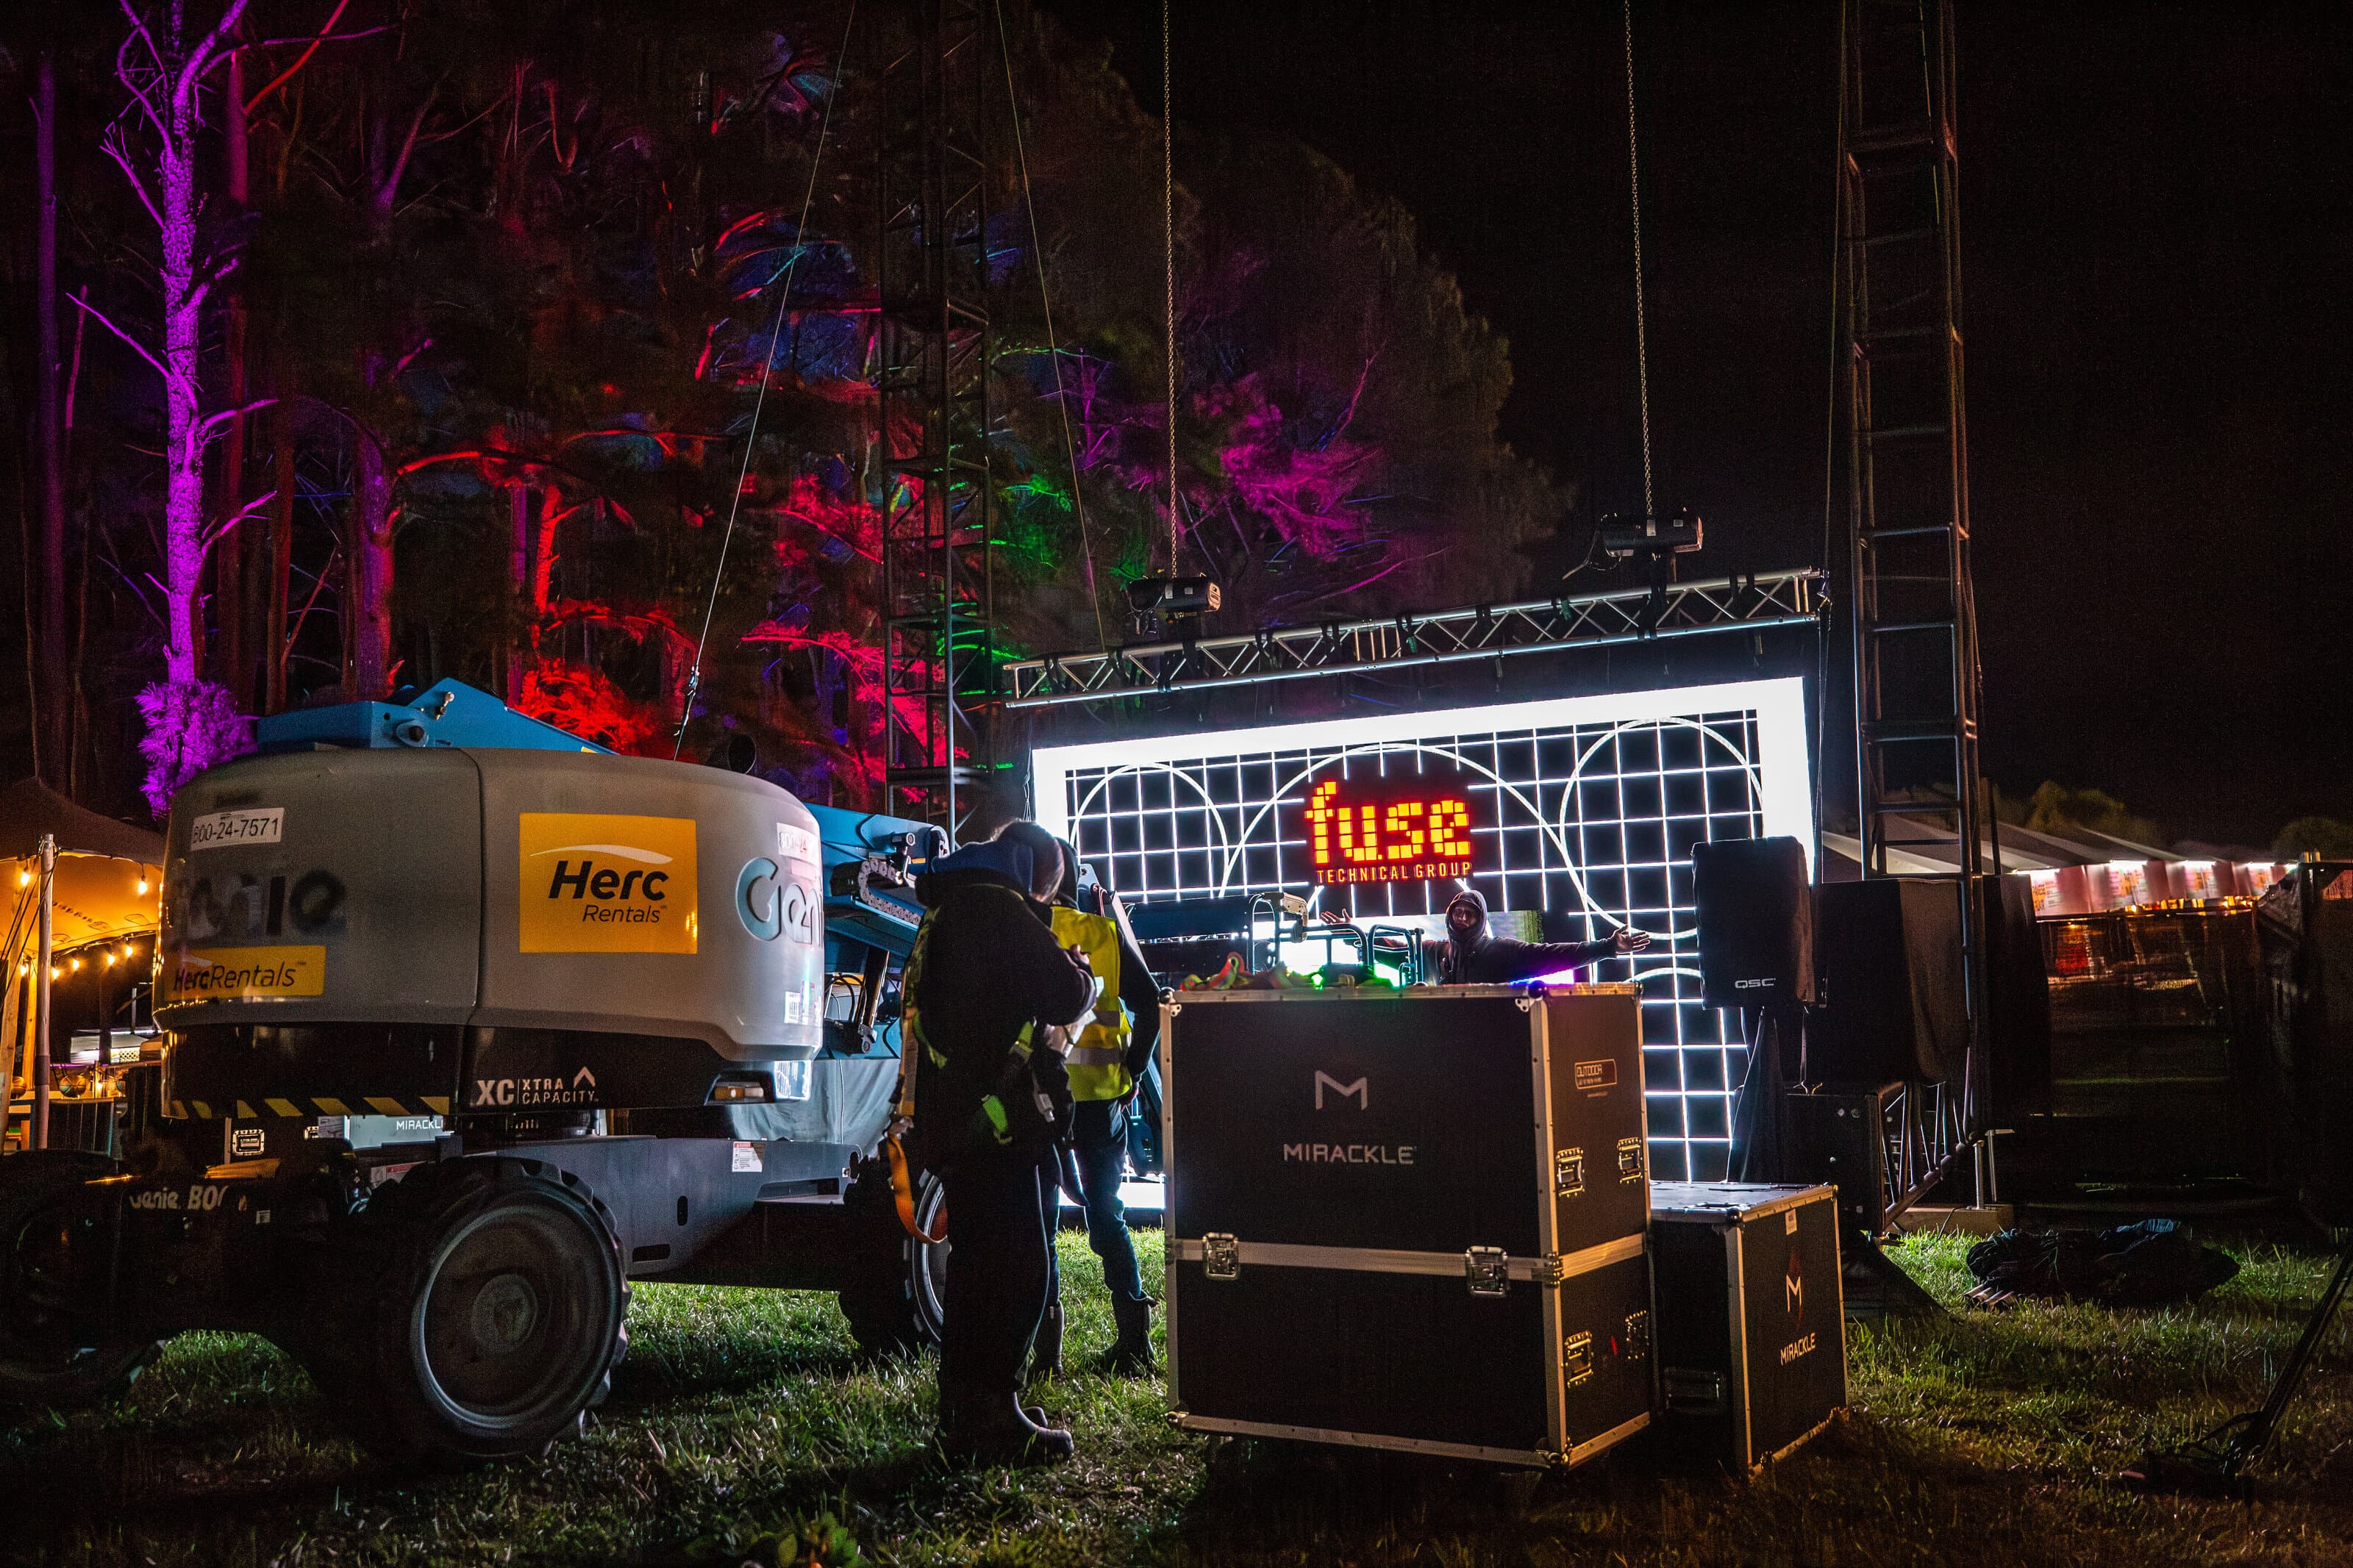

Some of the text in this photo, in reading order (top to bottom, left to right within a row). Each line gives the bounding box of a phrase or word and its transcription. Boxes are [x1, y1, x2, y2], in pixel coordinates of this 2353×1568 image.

[1305, 781, 1471, 864] fuse
[548, 860, 669, 901] Herc
[1317, 861, 1471, 884] TECHNICAL GROUP
[582, 904, 660, 923] Rentals
[1735, 978, 1777, 989] QSC
[476, 1078, 516, 1106] XC
[522, 1078, 563, 1090] XTRA
[522, 1090, 595, 1105] CAPACITY
[1283, 1143, 1414, 1165] MIRACKLE
[1780, 1332, 1817, 1366] MIRACKLE
